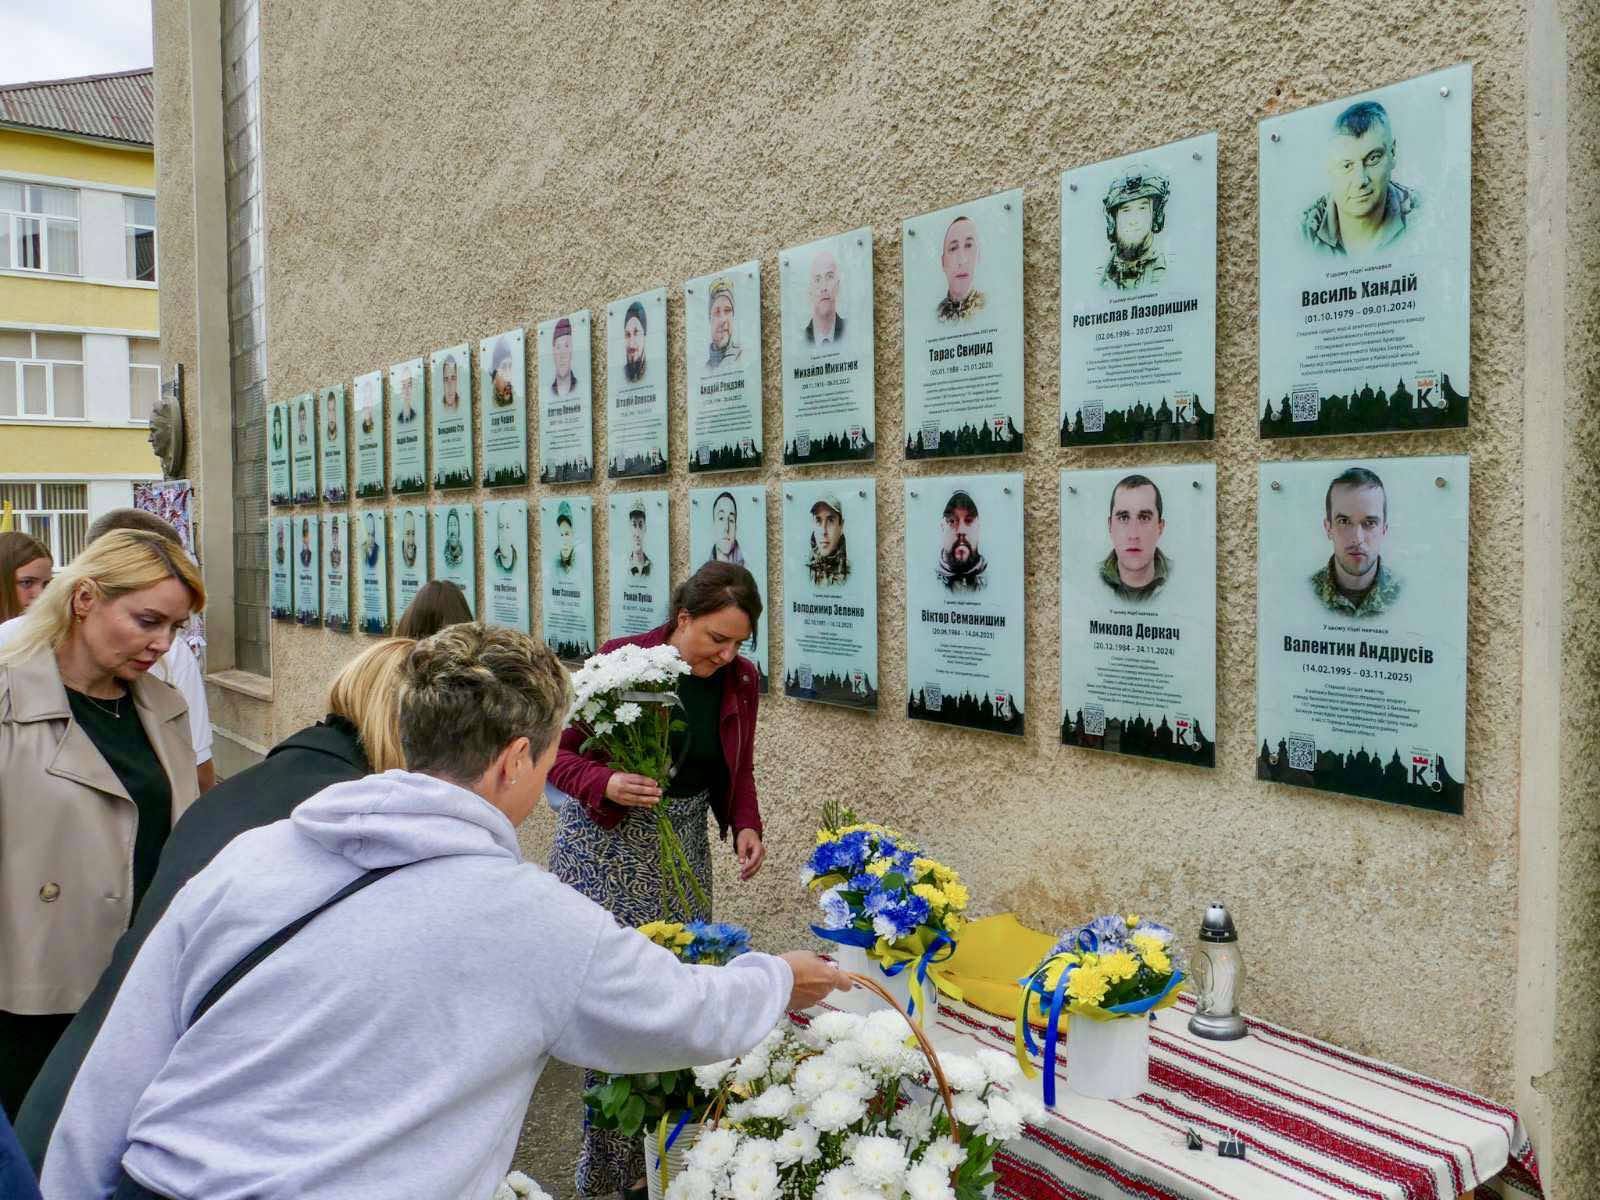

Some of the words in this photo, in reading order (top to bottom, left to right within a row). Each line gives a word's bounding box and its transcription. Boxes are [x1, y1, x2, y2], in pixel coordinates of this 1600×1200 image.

[1302, 286, 1357, 307] Василь
[1361, 272, 1418, 299] Хандій
[1073, 308, 1128, 328] Ростислав
[1131, 298, 1199, 320] Лазоришин
[1304, 309, 1354, 325] (01.10.1979
[1362, 299, 1416, 316] 09.01.2024)
[929, 347, 955, 362] Тарас
[957, 341, 993, 358] Свирид
[794, 364, 824, 379] Михайло
[825, 360, 858, 375] Микитюк
[793, 601, 833, 616] Володимир
[833, 604, 865, 618] Зеленко
[921, 609, 949, 624] Віктор
[951, 611, 1006, 627] Семанишин
[1089, 620, 1133, 637] Микола
[1135, 623, 1180, 641] Деркач
[1283, 635, 1356, 657] Валентин
[1358, 641, 1435, 665] Андрусів
[1302, 663, 1352, 677] (14.02.1995
[1359, 668, 1413, 683] 03.11.2025)
